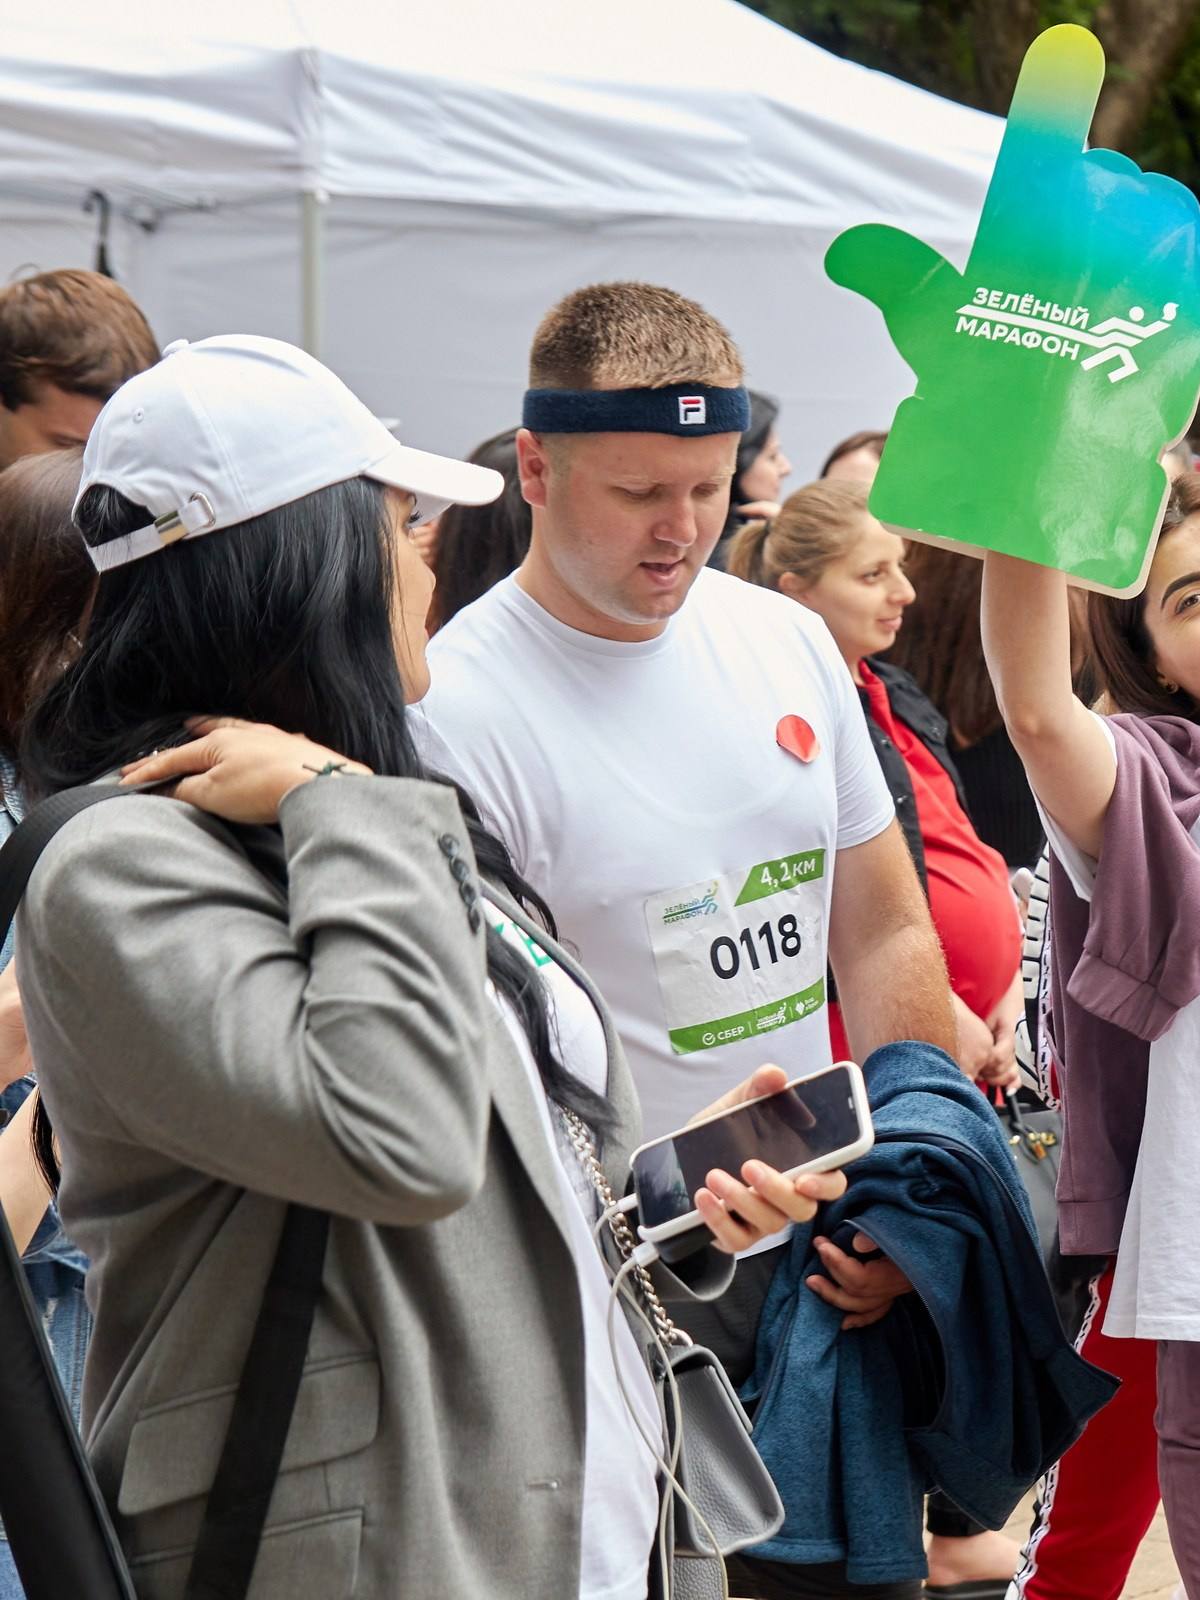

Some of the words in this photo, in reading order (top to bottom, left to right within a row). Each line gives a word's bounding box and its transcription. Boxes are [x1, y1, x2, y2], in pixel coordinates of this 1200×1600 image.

[972, 287, 1090, 330] ЗЕЛЁНЫЙ
[955, 316, 1080, 361] МАРАФОН
[710, 913, 801, 980] 0118
[716, 1025, 745, 1041] СБЕР
